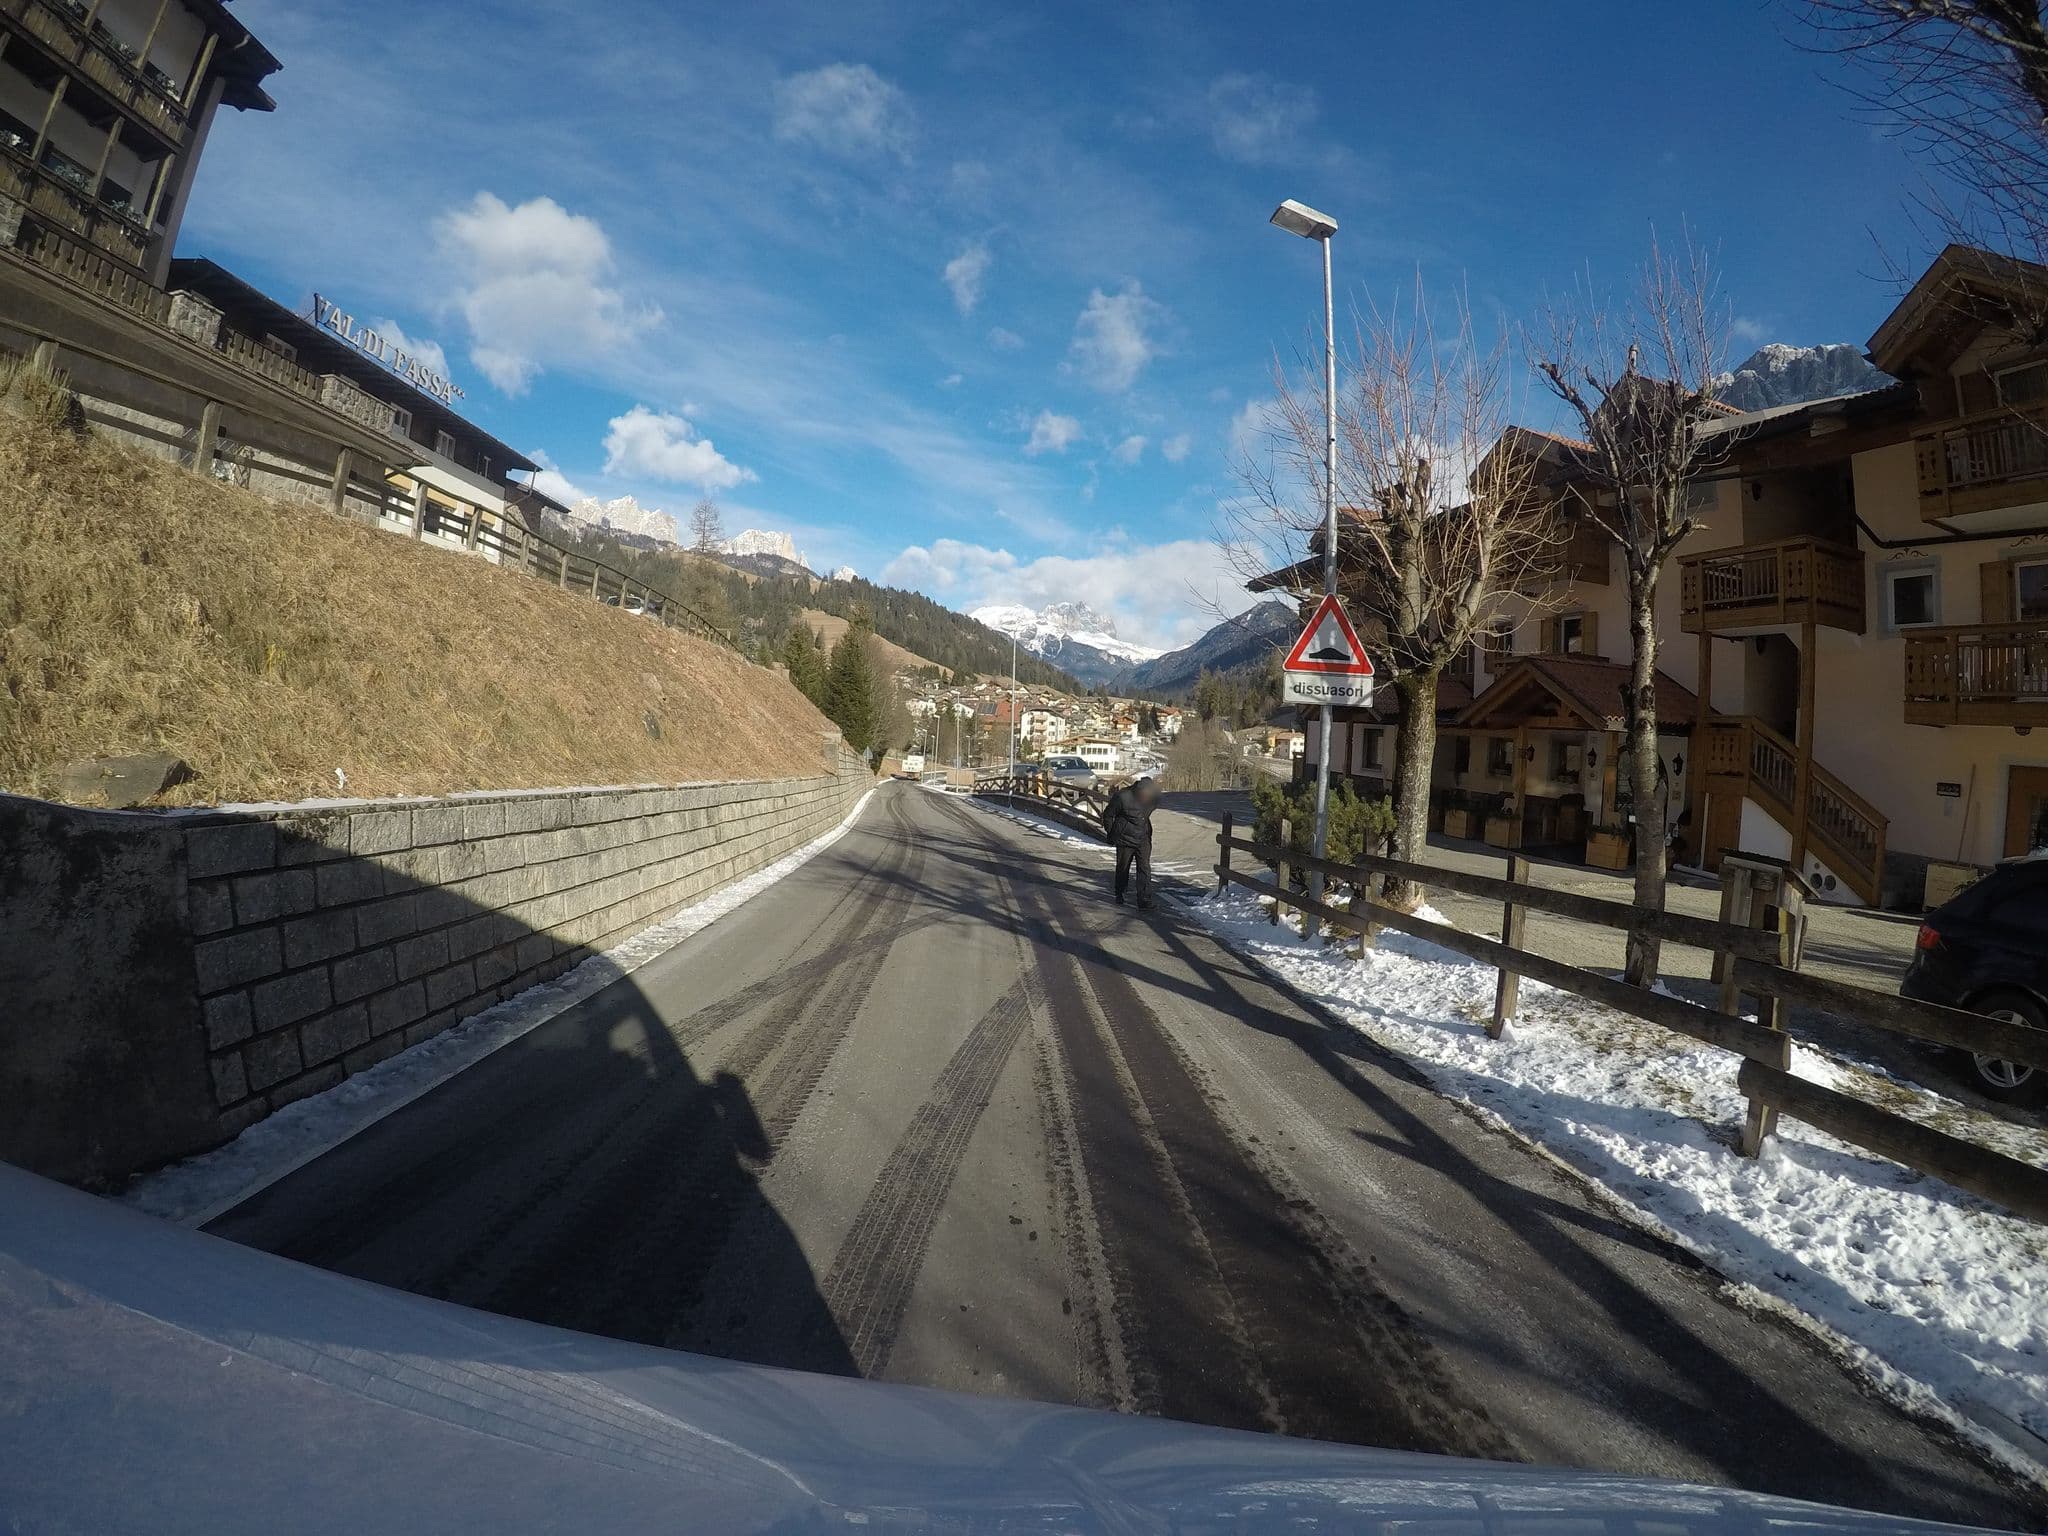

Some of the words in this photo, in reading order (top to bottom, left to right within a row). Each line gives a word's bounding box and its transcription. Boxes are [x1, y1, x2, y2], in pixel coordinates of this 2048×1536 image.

[315, 293, 359, 345] VAL
[364, 328, 387, 363] DI
[395, 347, 453, 404] FASSA
[1293, 682, 1363, 697] dissuasori
